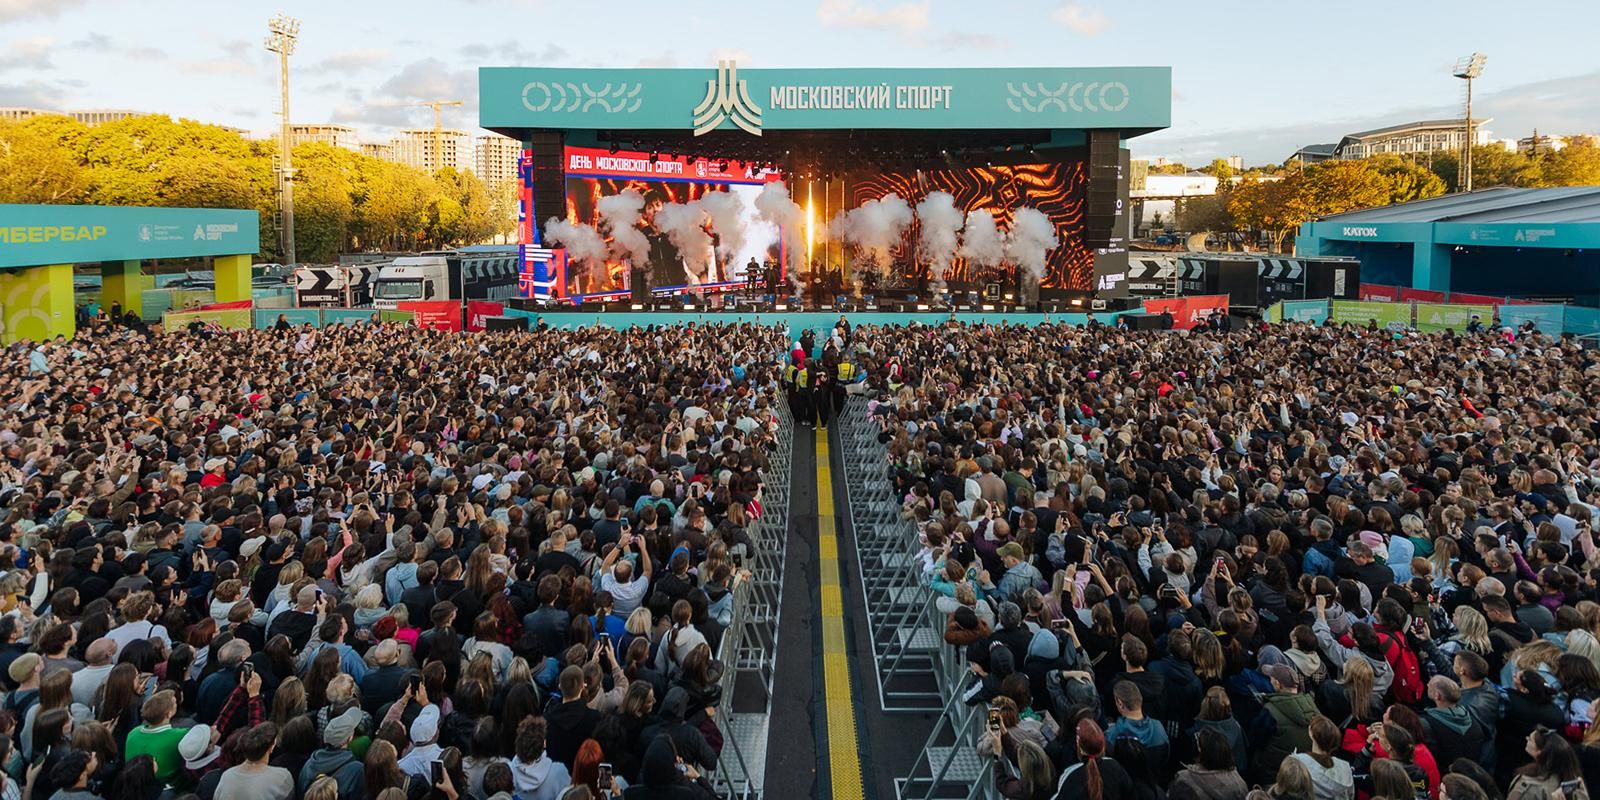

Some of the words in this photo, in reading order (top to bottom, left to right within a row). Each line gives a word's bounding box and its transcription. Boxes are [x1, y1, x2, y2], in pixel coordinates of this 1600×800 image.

[770, 83, 890, 109] МОСКОВСКИЙ
[896, 86, 952, 109] СПОРТ
[570, 155, 592, 170] ДЕНЬ
[596, 156, 652, 173] МОСКОВСКОГО
[655, 160, 682, 174] СПОРТА
[1343, 227, 1377, 237] КАТОК
